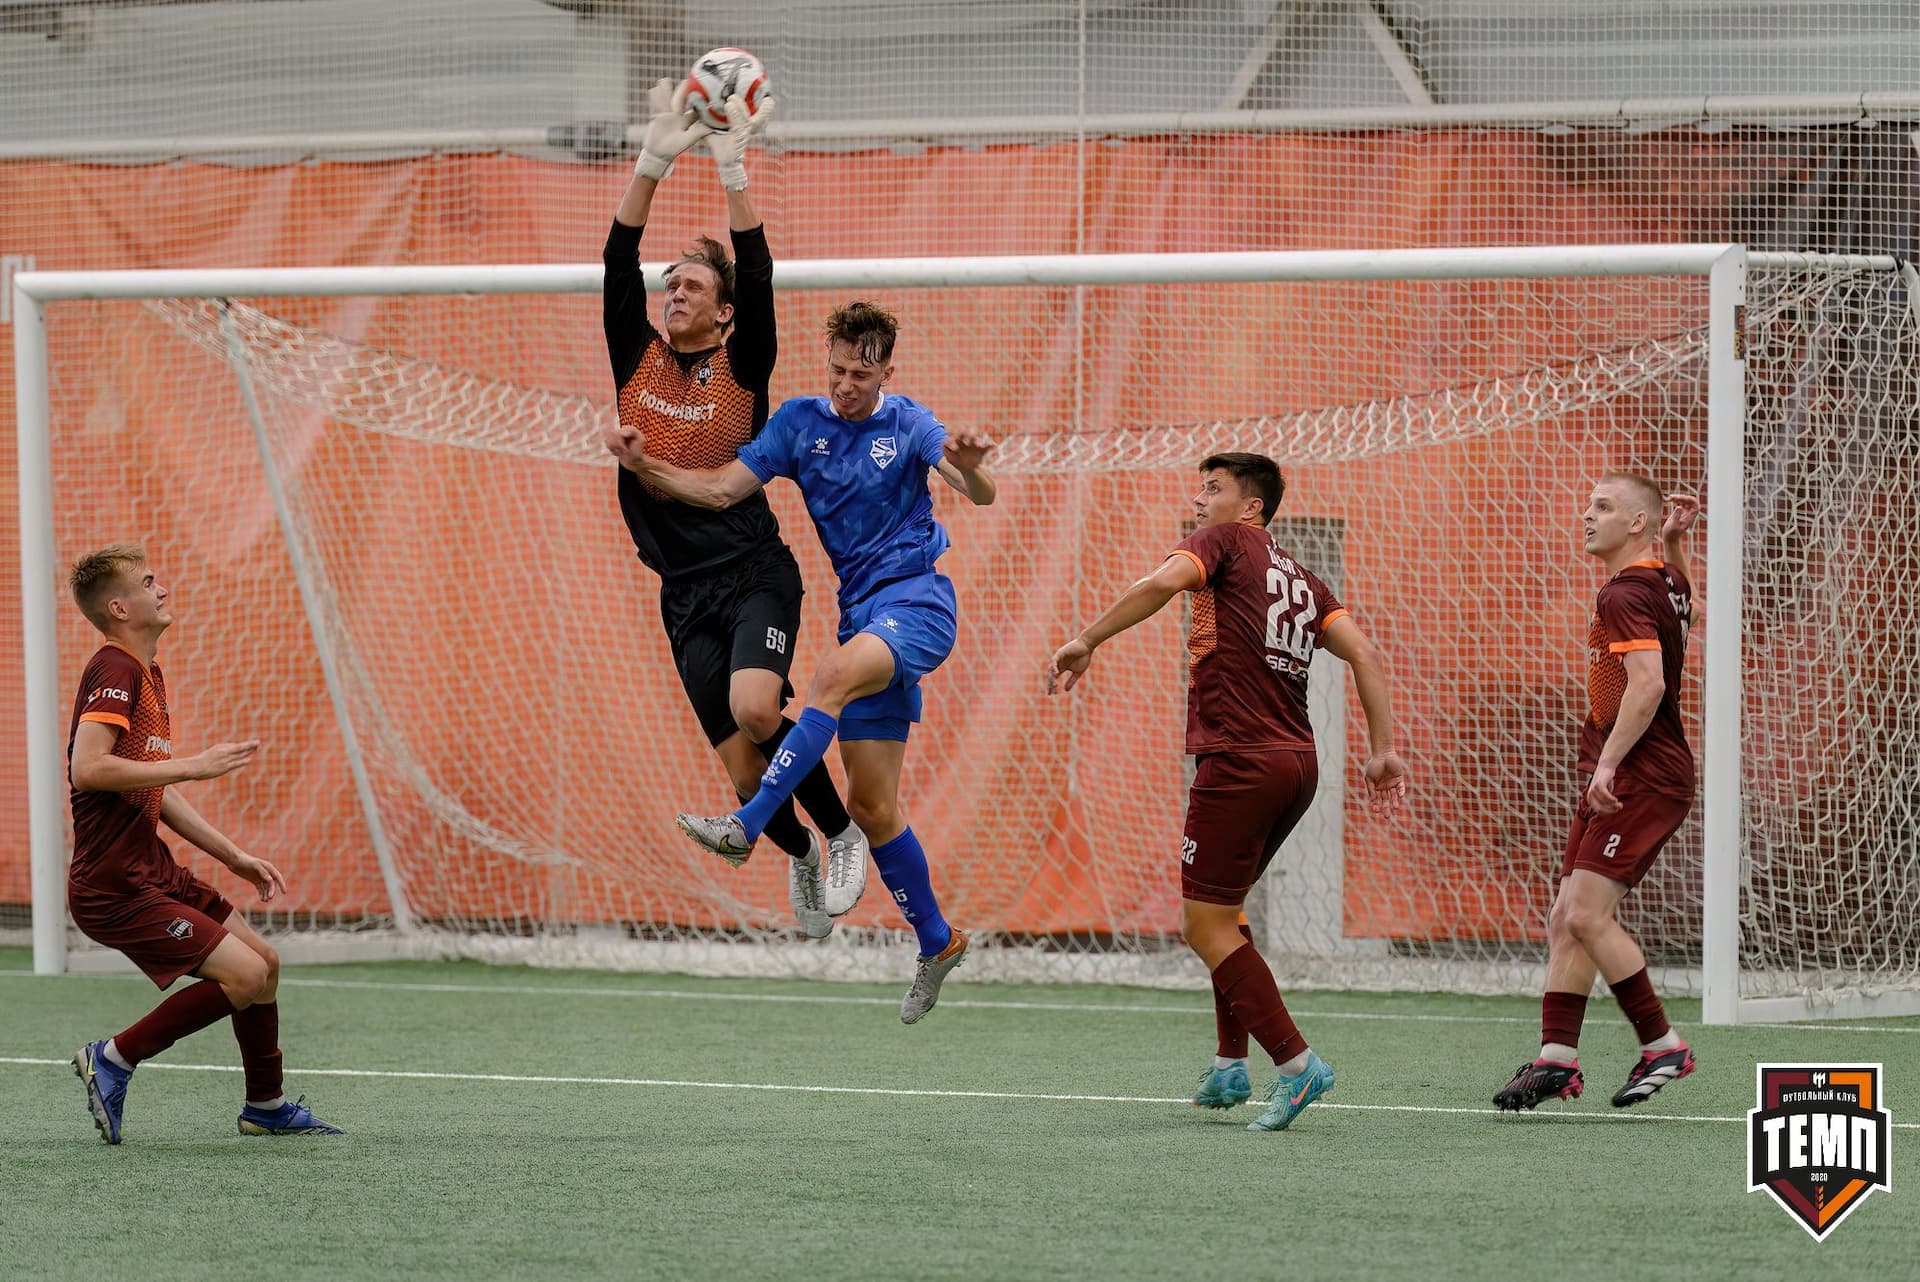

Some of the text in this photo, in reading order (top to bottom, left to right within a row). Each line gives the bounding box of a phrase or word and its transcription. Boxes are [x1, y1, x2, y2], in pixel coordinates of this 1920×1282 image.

[1265, 567, 1317, 663] 22
[766, 626, 787, 655] 59
[102, 687, 129, 702] ПСБ
[1181, 835, 1198, 865] 22
[1603, 834, 1621, 858] 2
